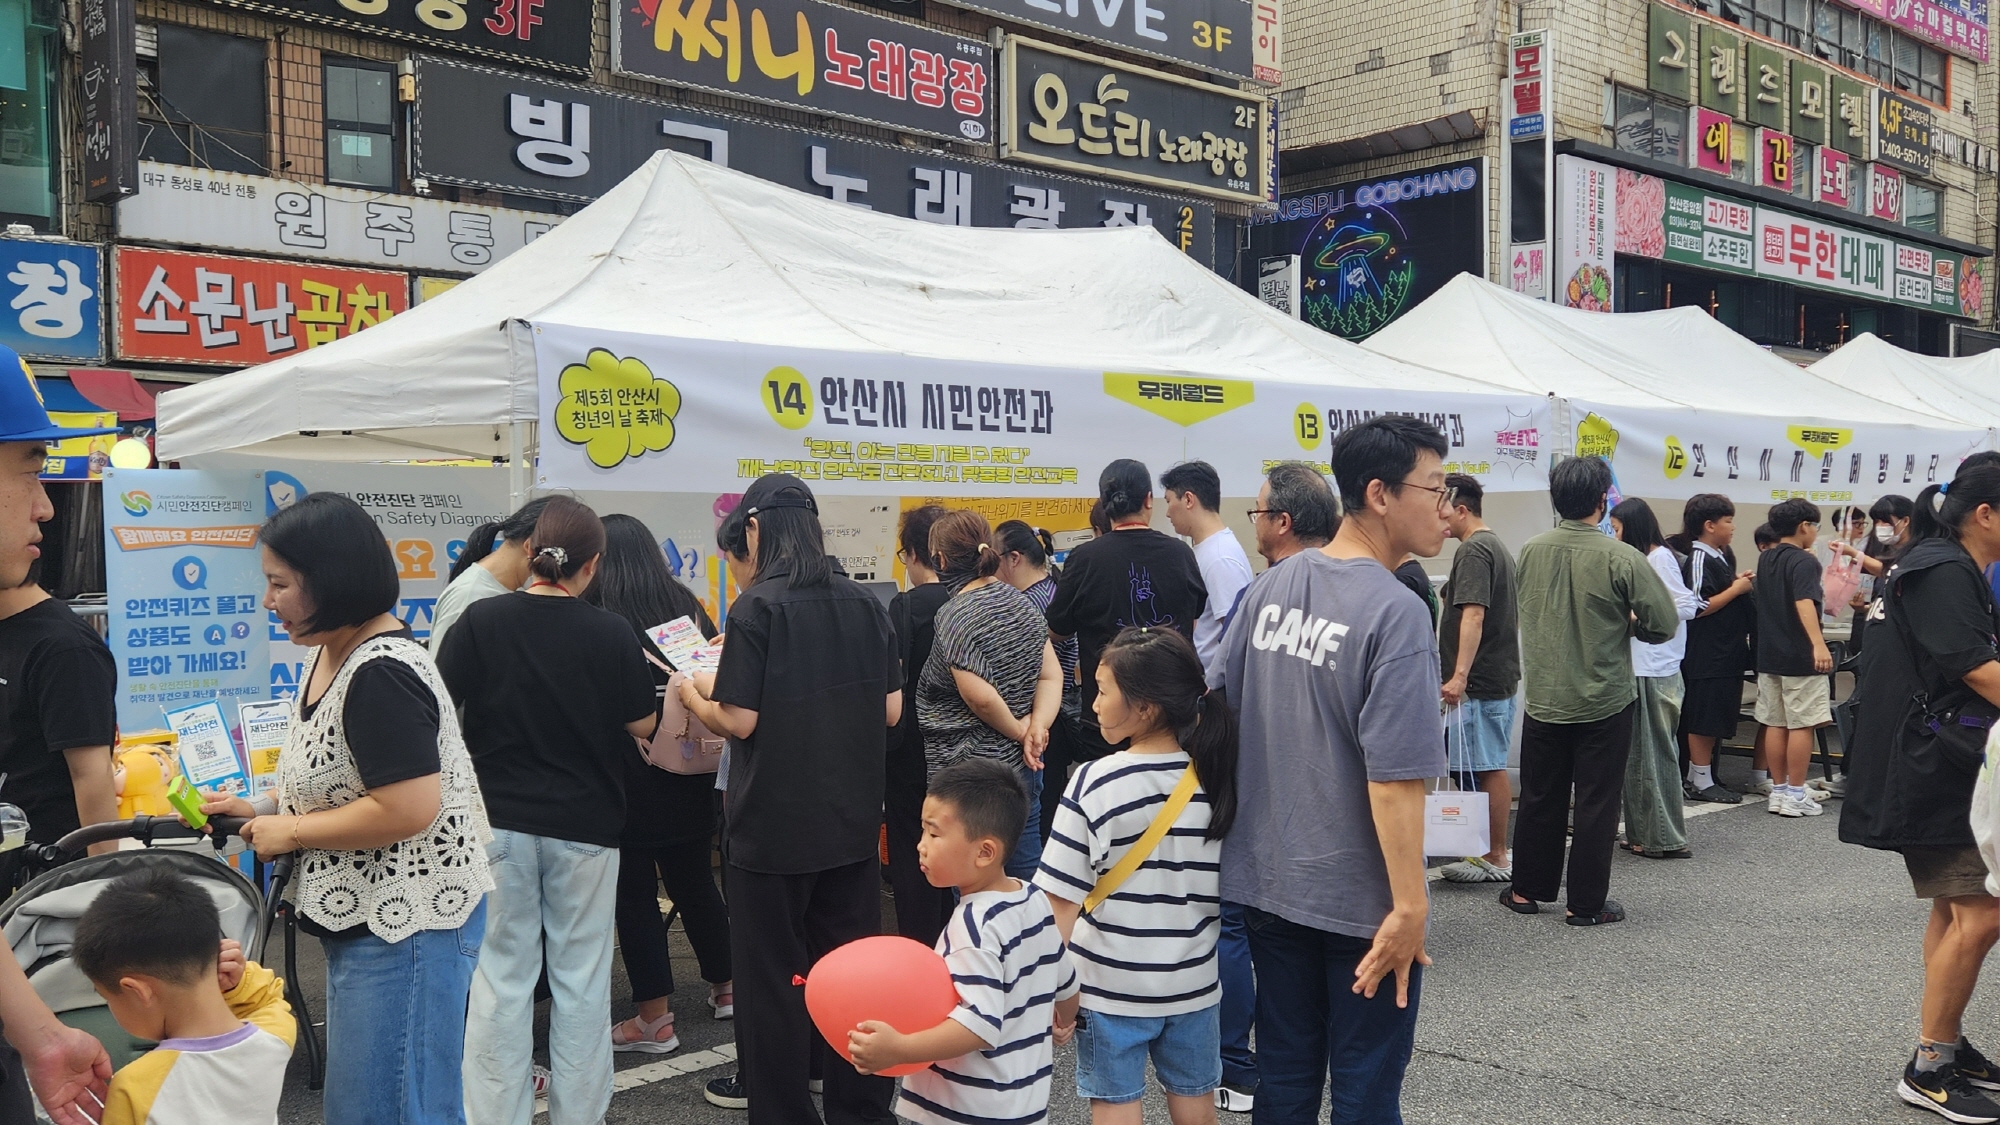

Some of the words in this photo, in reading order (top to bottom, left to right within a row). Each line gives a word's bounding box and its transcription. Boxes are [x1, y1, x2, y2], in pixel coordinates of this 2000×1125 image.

[483, 0, 544, 41] 3F
[1024, 0, 1168, 41] VE
[1192, 21, 1232, 51] 3F
[1913, 2, 1981, 49] 슈마컬렉션
[654, 0, 815, 96] 써니
[824, 27, 987, 117] 노래광장
[956, 42, 983, 57] 유흥주점
[1513, 47, 1541, 115] 모텔
[1029, 73, 1151, 157] 오드리
[1158, 129, 1249, 177] 노래광장
[1235, 106, 1256, 129] 2F
[962, 122, 983, 137] 지하
[1880, 139, 1930, 169] T:403-5571-2
[143, 172, 167, 188] 대구
[171, 176, 204, 193] 동성로
[207, 181, 231, 196] 40년
[235, 183, 257, 199] 전통
[1227, 179, 1250, 191] 유흥주점
[1354, 166, 1478, 208] GOBCHANG
[1822, 156, 1848, 201] 노래
[1873, 171, 1899, 214] 광장
[1669, 196, 1702, 216] 안산중앙점
[1708, 201, 1749, 231] 고기무한
[1707, 236, 1749, 265] 소주무한
[1899, 247, 1930, 272] 라면무한
[8, 259, 93, 340] 창
[1261, 279, 1290, 301] 별난
[1899, 276, 1930, 301] 샐러드바
[574, 388, 612, 408] 제5회
[617, 387, 660, 407] 안산시
[1138, 380, 1224, 404] 무해월드
[768, 380, 806, 415] 14
[820, 376, 907, 428] 안산시
[922, 382, 1054, 434] 시민안전과
[572, 409, 614, 430] 청년의
[618, 409, 632, 428] 날
[636, 408, 665, 427] 축제
[1298, 413, 1319, 439] 13
[1581, 434, 1595, 446] 제5회
[1595, 434, 1611, 445] 안산시
[1801, 430, 1839, 445] 무해월드
[857, 441, 896, 460] 아는
[935, 444, 970, 463] 지킬
[972, 445, 990, 463] 수
[1667, 445, 1684, 470] 12
[822, 461, 882, 481] 인식도
[962, 465, 1013, 484] 맞춤형
[1013, 466, 1079, 485] 안전교육
[1462, 461, 1490, 474] Youth
[157, 500, 252, 513] 시민안전진단캠페인
[356, 493, 416, 508] 안전진단
[419, 493, 463, 509] 캠페인
[977, 501, 1032, 521] 재난위기를
[387, 511, 436, 527] Safety
[441, 513, 511, 527] Diagnosis
[118, 528, 187, 545] 함께해요
[190, 527, 255, 543] 안전진단
[848, 556, 877, 568] 안전교육
[125, 597, 211, 619] 안전퀴즈
[216, 595, 256, 616] 풀고
[127, 626, 191, 648] 상품도
[128, 654, 172, 677] 받아
[177, 650, 247, 673] 가세요!
[157, 690, 190, 702] 발견으로
[192, 689, 217, 699] 재난을
[178, 718, 219, 737] 재난안전
[249, 721, 289, 733] 재난안전
